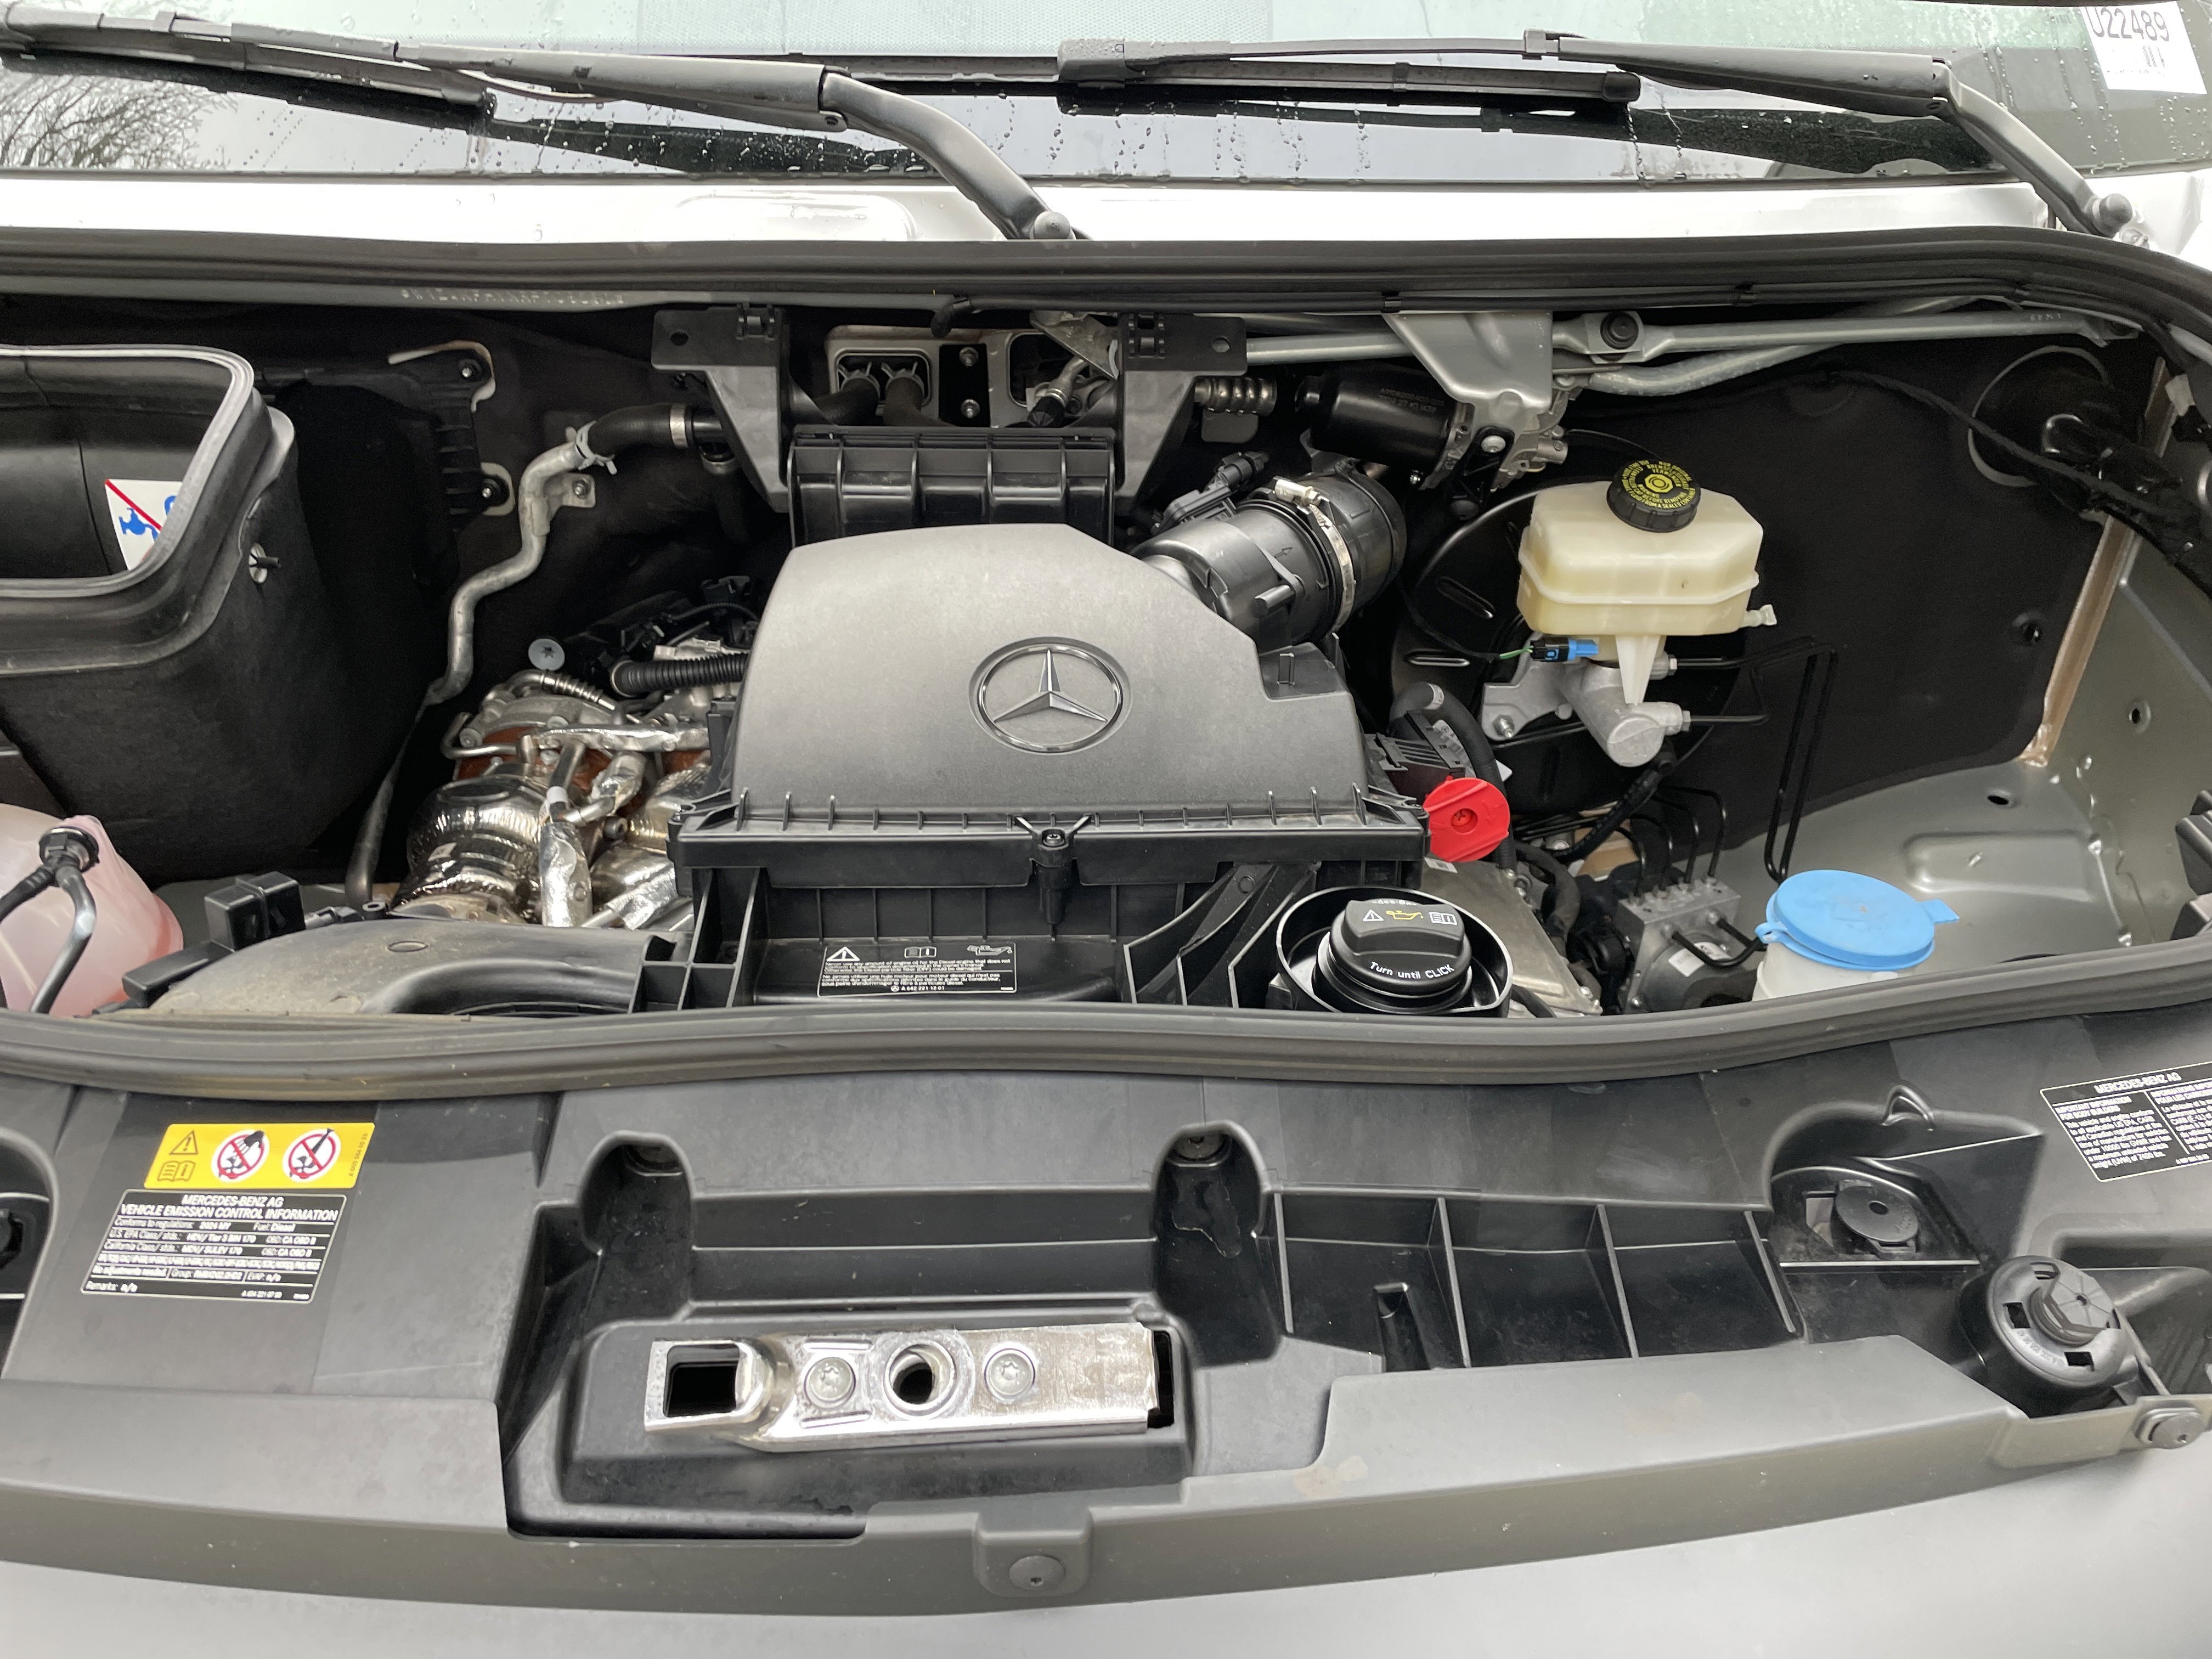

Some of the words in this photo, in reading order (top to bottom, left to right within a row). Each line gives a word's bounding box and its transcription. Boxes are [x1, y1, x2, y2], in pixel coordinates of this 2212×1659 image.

[1370, 961, 1393, 976] Turn
[1397, 970, 1421, 979] until
[1425, 964, 1454, 978] CLICK
[2094, 1074, 2168, 1094] MERCEDES-BENZ
[2166, 1072, 2182, 1082] AG
[2055, 1103, 2090, 1114] IMPORTANT
[2089, 1096, 2132, 1108] INFORMATION
[2137, 1116, 2155, 1124] CARB
[181, 1194, 268, 1207] MERCEDES-BENZ
[266, 1197, 284, 1207] AG
[121, 1204, 164, 1216] VEHICLE
[163, 1205, 215, 1217] EMISSION
[215, 1206, 263, 1219] CONTROL
[264, 1209, 338, 1221] INFORMATION
[218, 1222, 232, 1230] MY
[270, 1223, 296, 1232] Diesel
